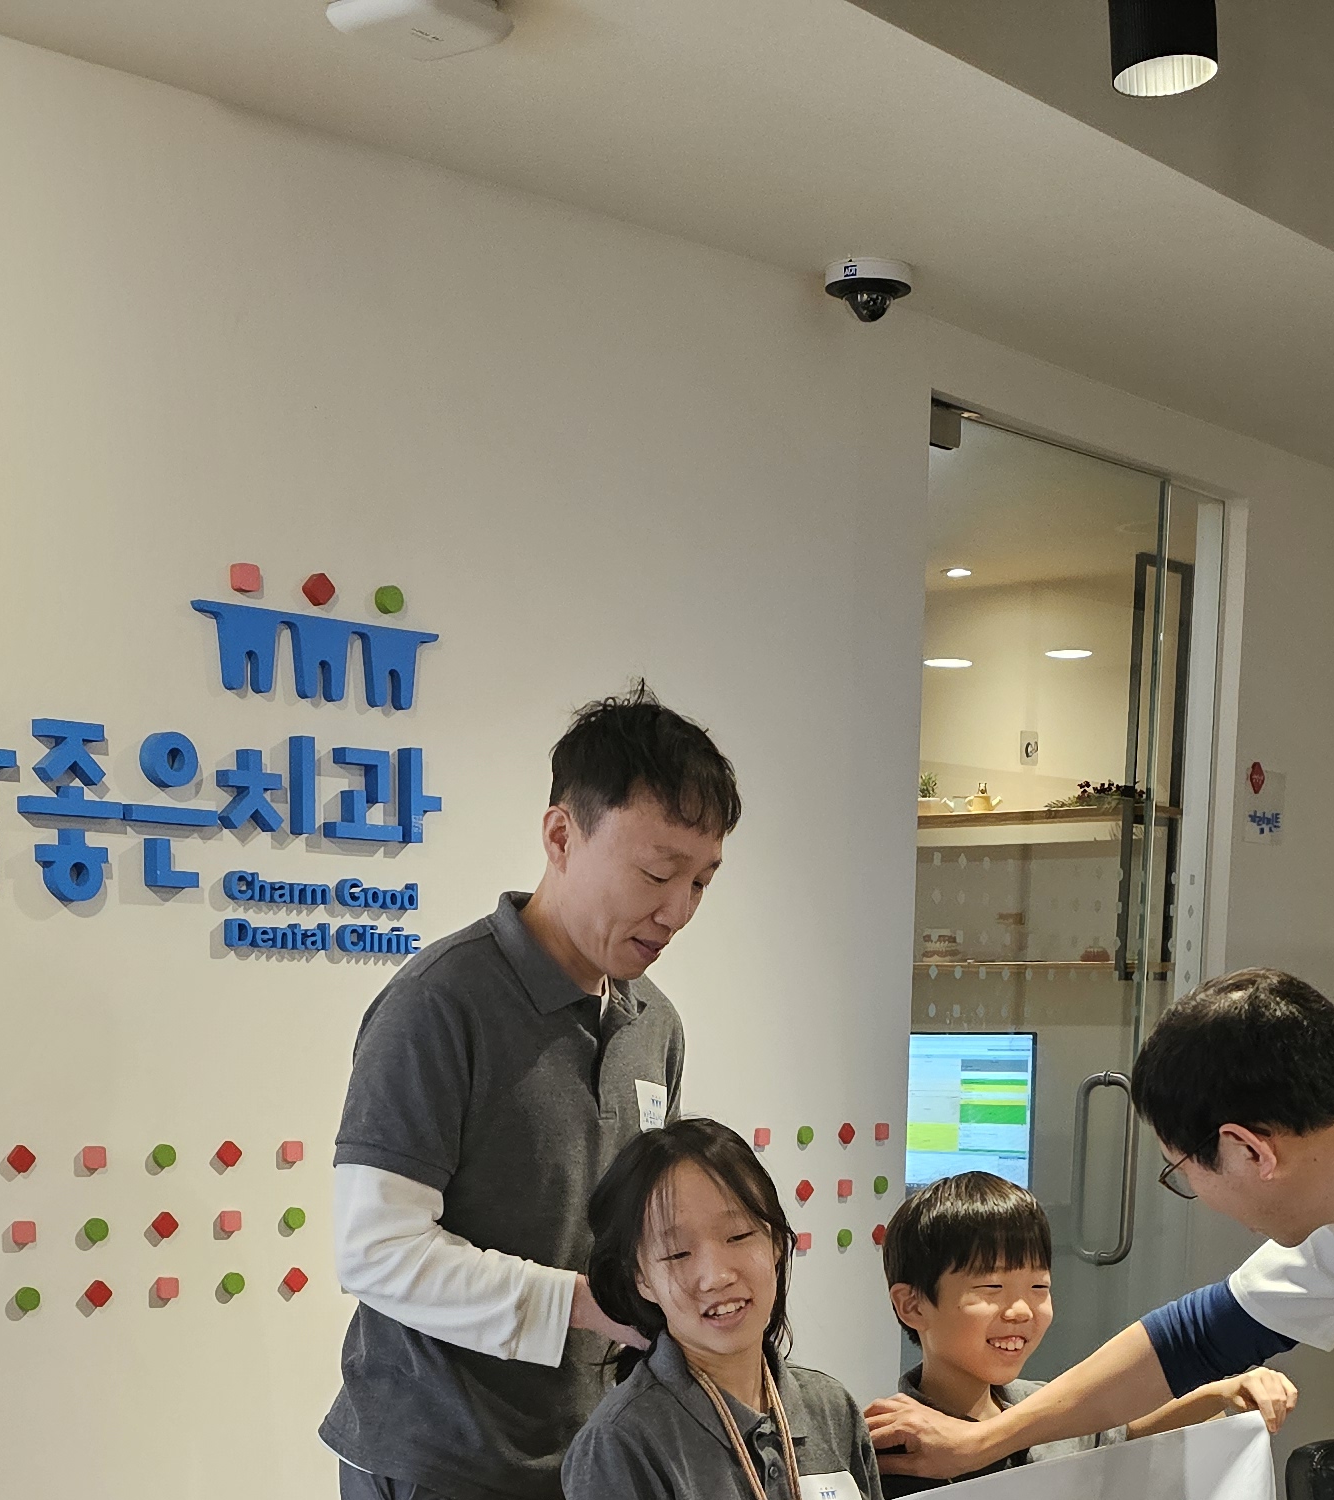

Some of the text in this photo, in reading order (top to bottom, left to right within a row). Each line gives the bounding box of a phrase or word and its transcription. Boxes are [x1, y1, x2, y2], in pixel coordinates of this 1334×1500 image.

[844, 266, 856, 276] ADT
[223, 870, 419, 910] Charm Good
[224, 918, 421, 954] Dental Clinic
